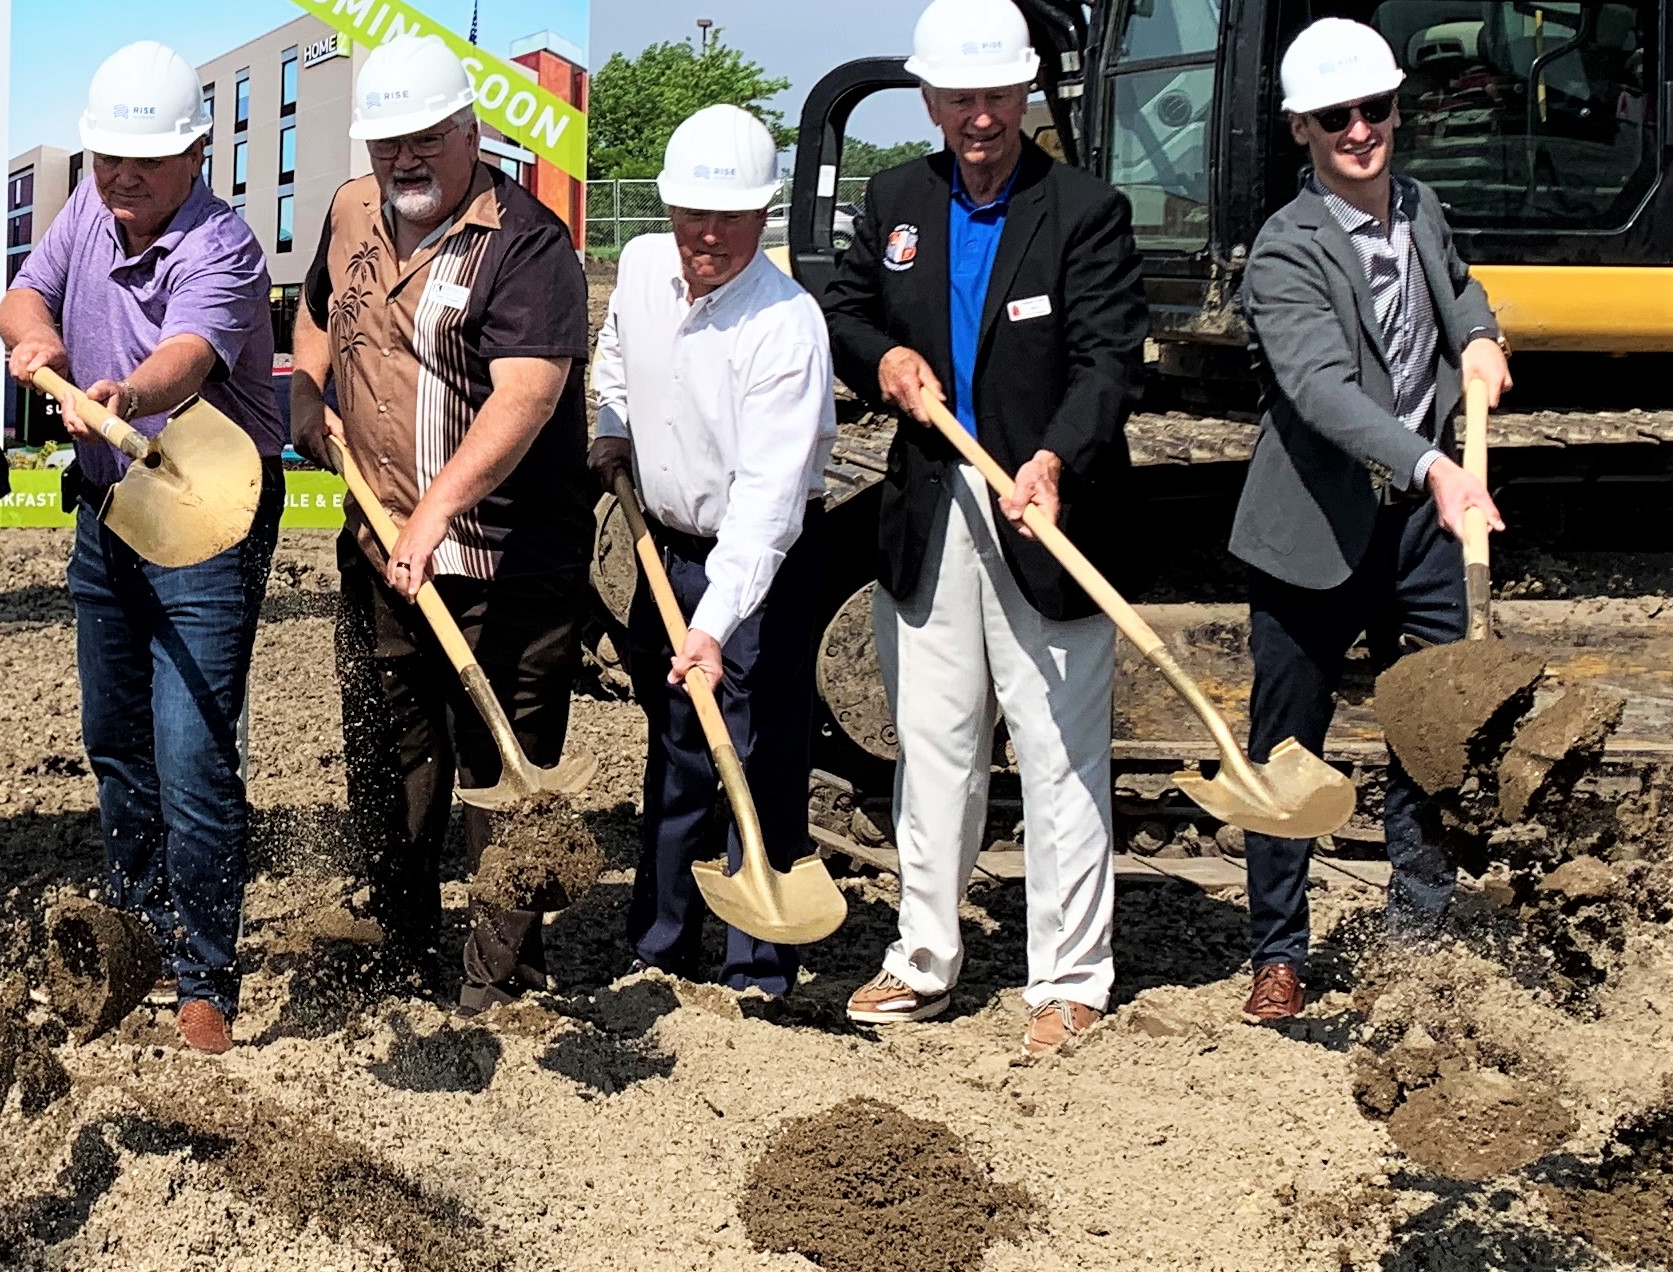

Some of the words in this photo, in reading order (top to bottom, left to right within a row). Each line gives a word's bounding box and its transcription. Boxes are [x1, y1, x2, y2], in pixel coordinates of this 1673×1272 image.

[383, 90, 409, 101] RISE
[133, 106, 156, 115] RISE
[316, 493, 326, 508] &
